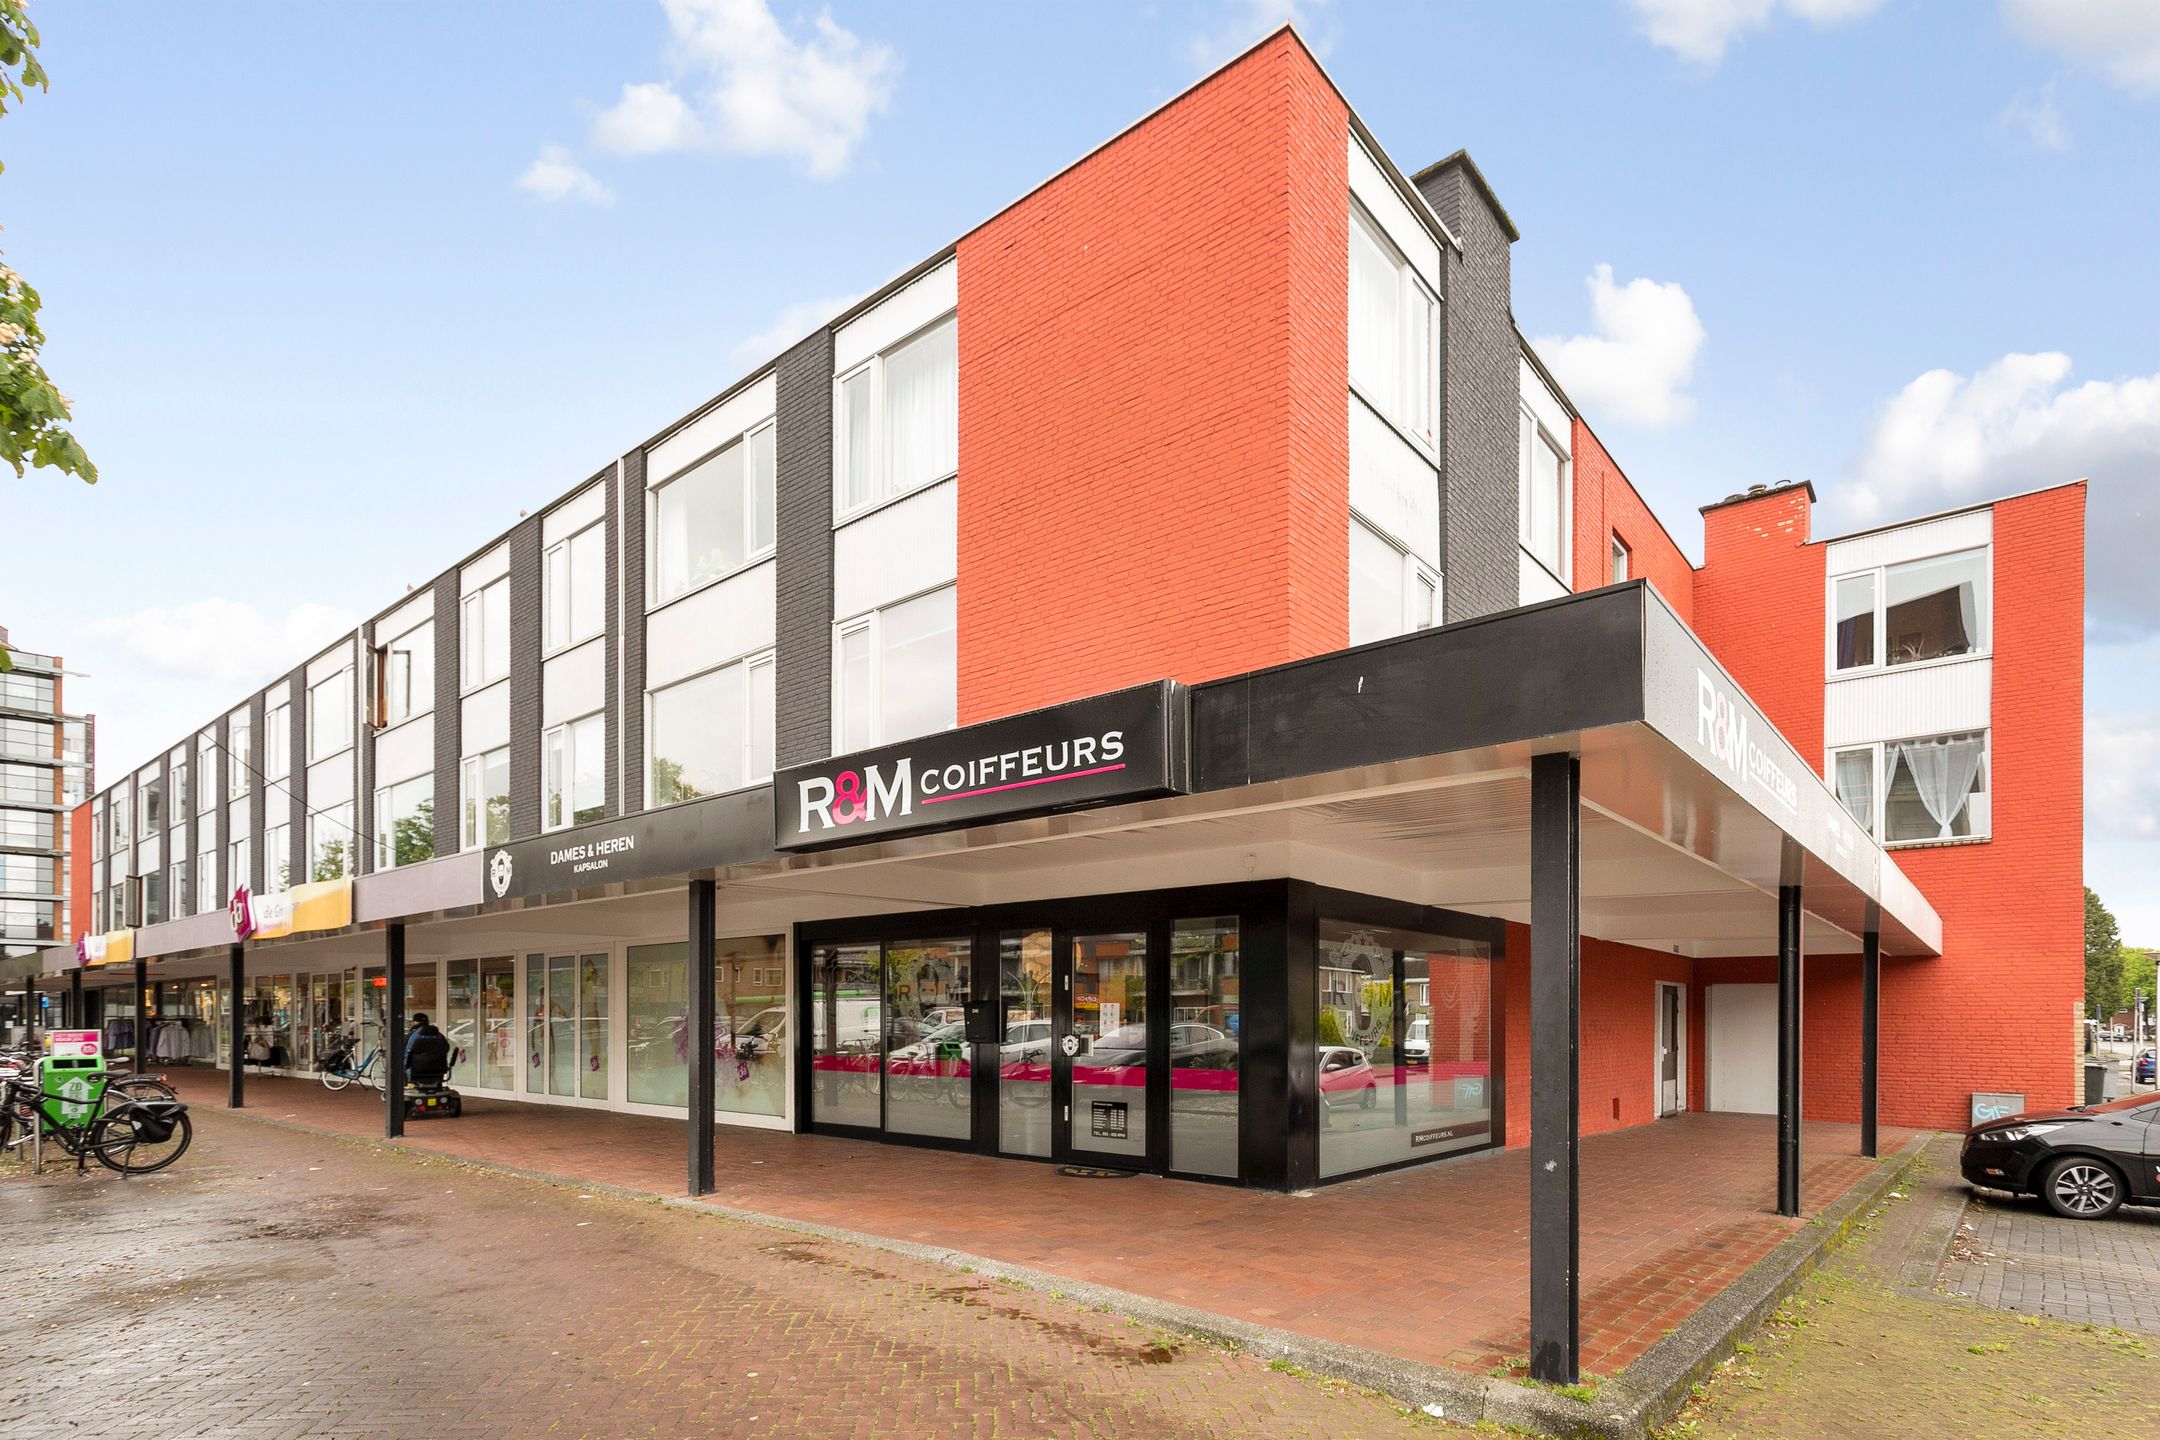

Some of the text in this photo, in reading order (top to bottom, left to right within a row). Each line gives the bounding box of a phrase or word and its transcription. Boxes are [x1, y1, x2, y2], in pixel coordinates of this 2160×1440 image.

[1697, 667, 1798, 807] R&M COIFFEURS
[798, 731, 1126, 834] R&M COIFFEURS
[550, 835, 635, 865] DAMES & HEREN
[573, 859, 609, 874] KAPSALON
